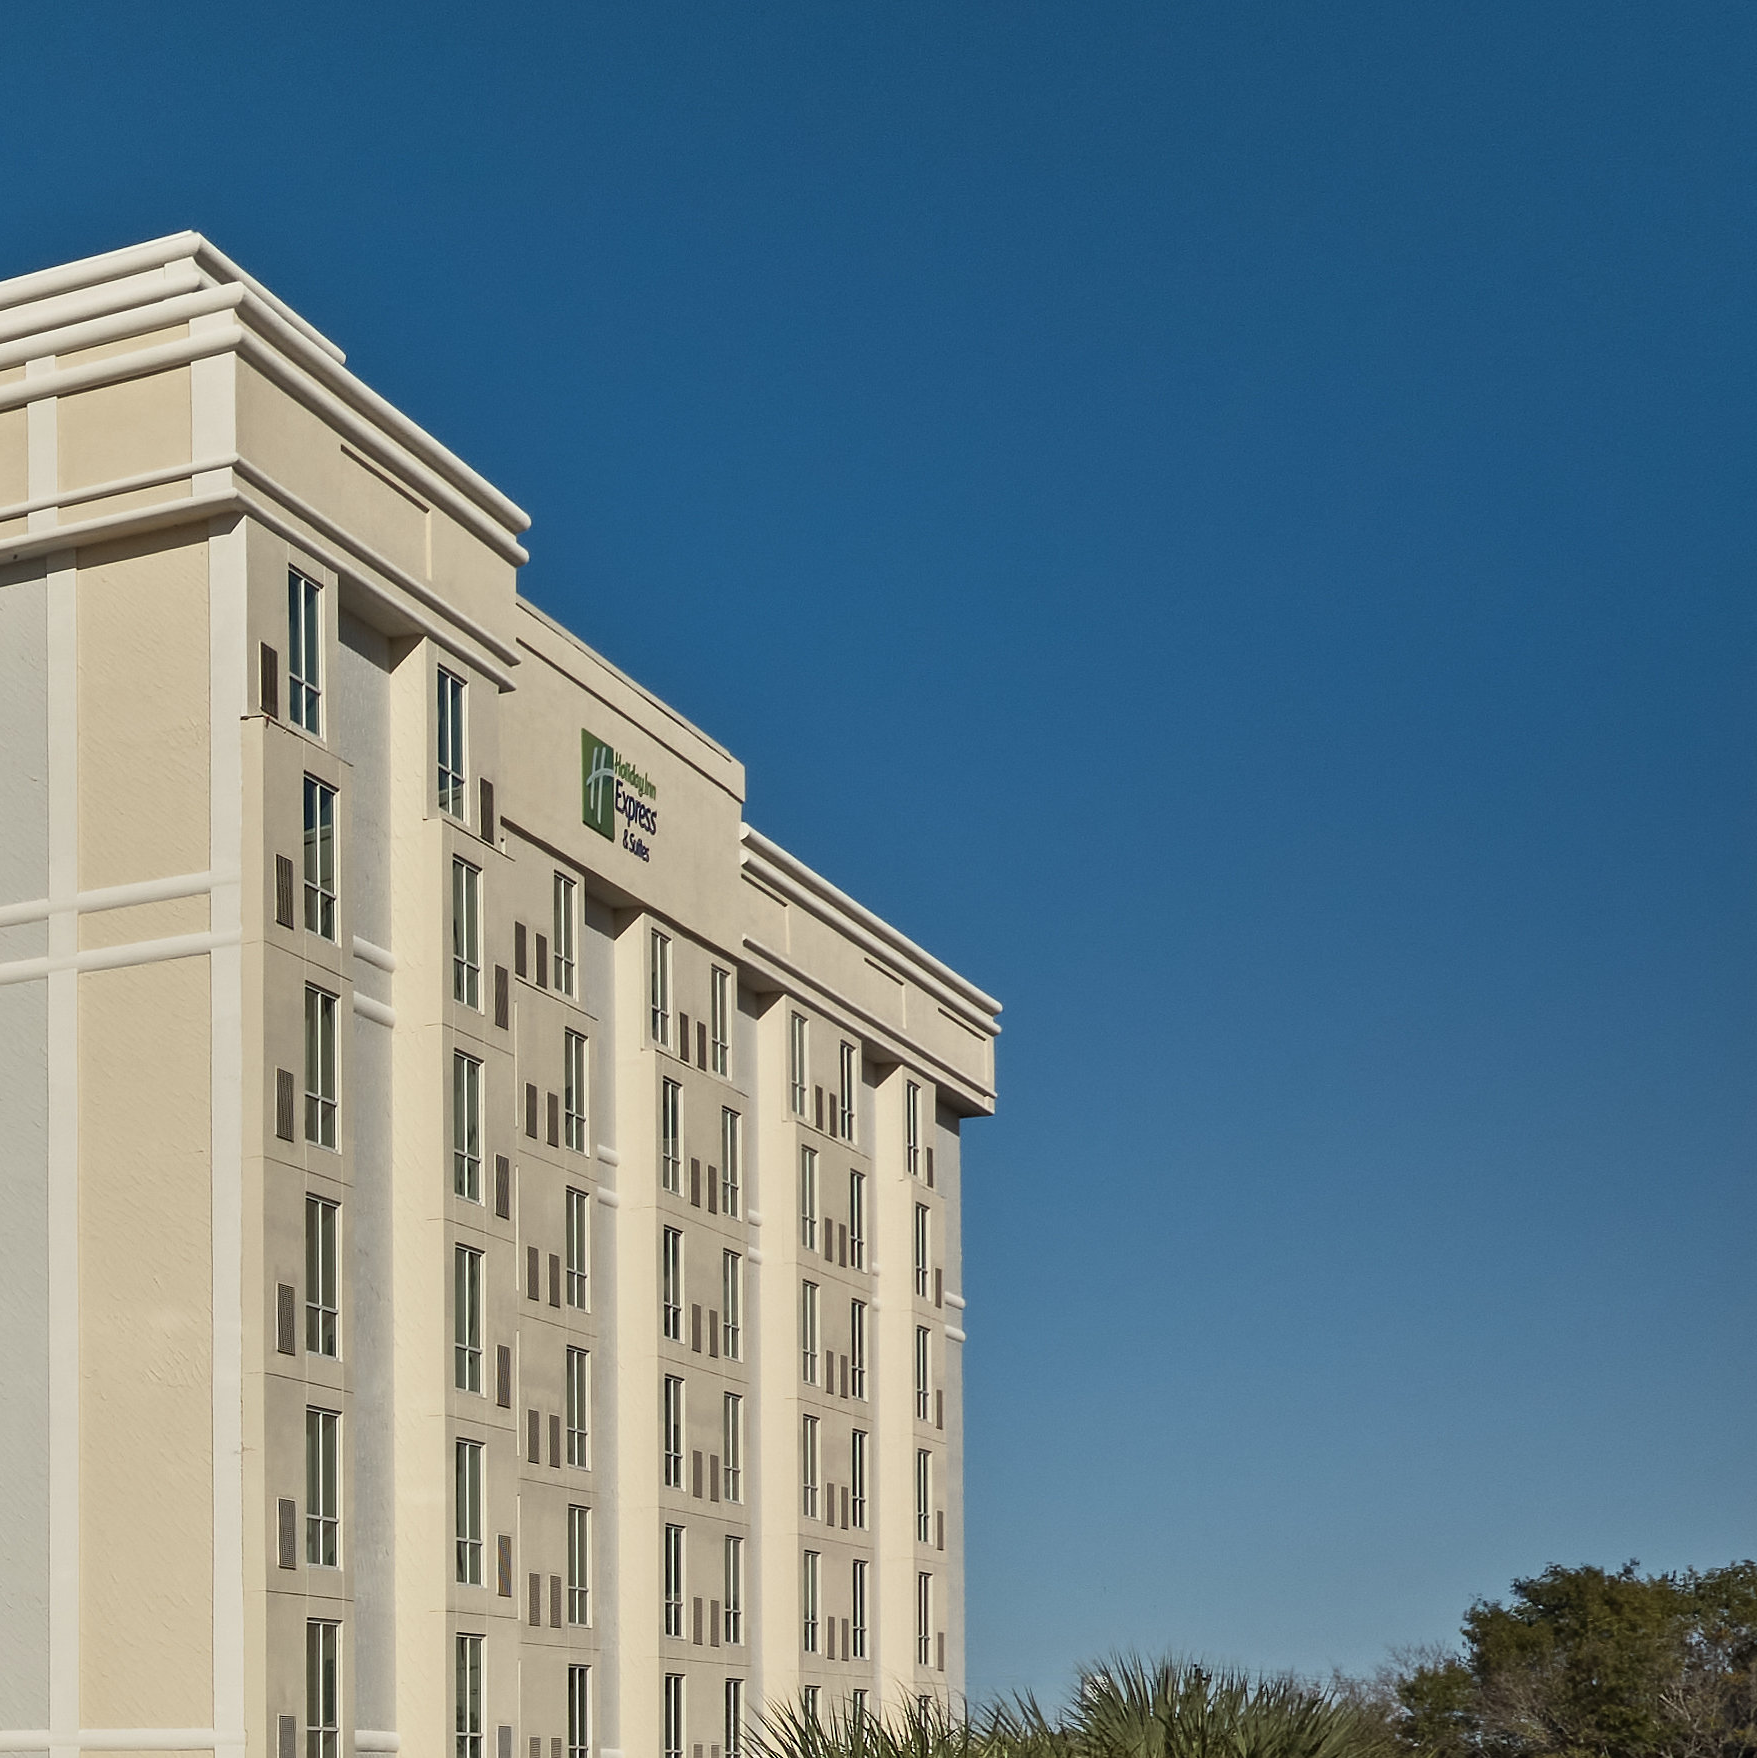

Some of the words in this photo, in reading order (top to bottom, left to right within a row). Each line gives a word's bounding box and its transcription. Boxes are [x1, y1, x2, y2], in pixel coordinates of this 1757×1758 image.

[615, 752, 644, 797] Holiday
[645, 772, 656, 800] Inn
[615, 779, 657, 836] Express
[623, 829, 629, 850] &
[629, 833, 650, 863] Suites
